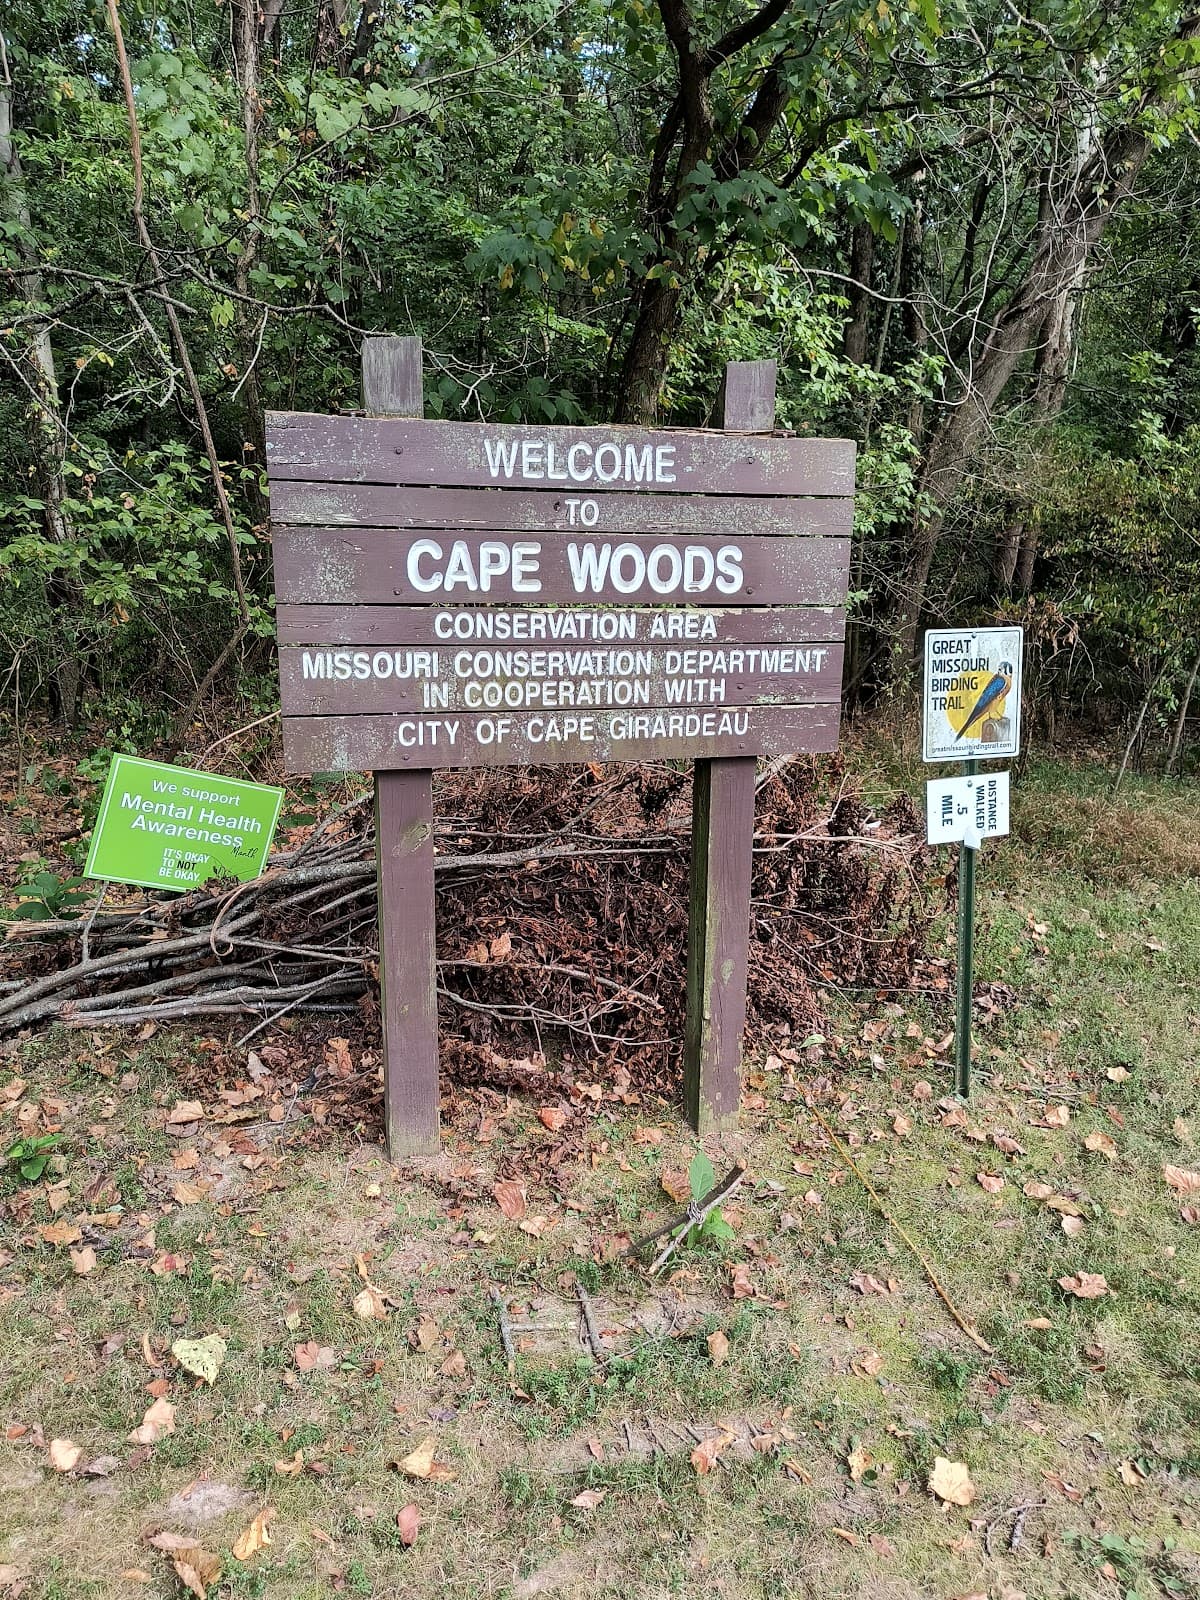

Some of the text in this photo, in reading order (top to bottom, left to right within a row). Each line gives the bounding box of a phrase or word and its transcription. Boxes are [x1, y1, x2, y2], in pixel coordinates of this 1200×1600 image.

[484, 439, 677, 483] WELCOME
[565, 499, 599, 526] TO
[407, 539, 744, 594] CAPE WOODS
[434, 611, 718, 639] CONSERVATION AREA
[932, 639, 971, 654] GREAT
[302, 647, 827, 679] MISSOURI CONSERVATION DEPARTMENT
[932, 657, 989, 673] MISSOURI
[423, 677, 727, 708] IN COOPERATION WITH
[931, 676, 978, 692] BIRDING
[931, 696, 964, 711] TRAIL
[398, 711, 750, 747] CITY OF CAPE GIRARDEAU
[152, 779, 240, 806] We support
[975, 785, 985, 828] WALKED
[988, 780, 996, 831] DISTANCE
[121, 793, 262, 834] Mental Health
[941, 795, 953, 827] MILE
[957, 803, 968, 815] .5
[131, 814, 243, 848] Awareness
[162, 857, 197, 871] TO NOT
[163, 848, 210, 864] IT'S OKAY
[159, 866, 171, 877] BE
